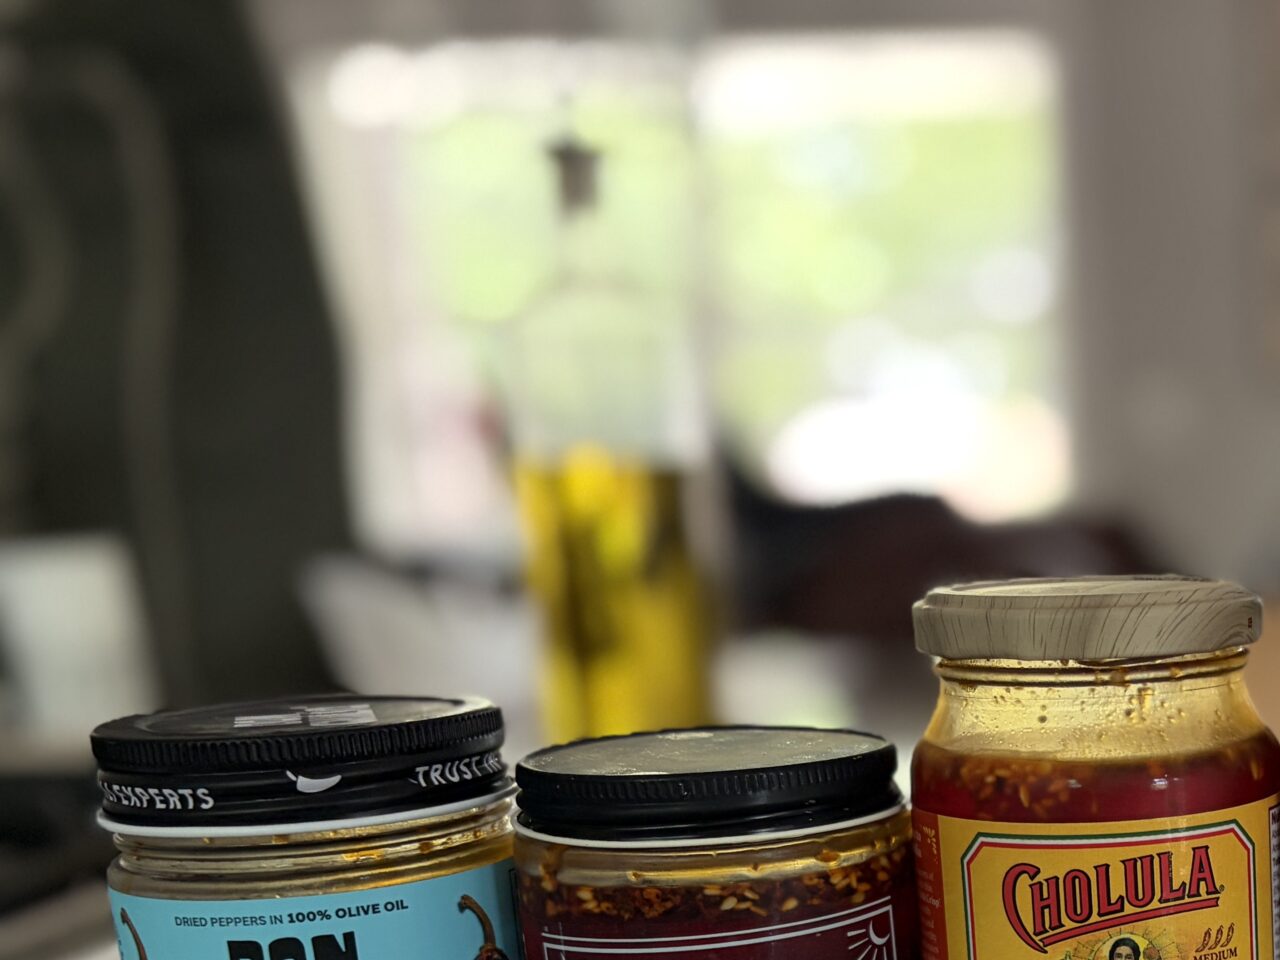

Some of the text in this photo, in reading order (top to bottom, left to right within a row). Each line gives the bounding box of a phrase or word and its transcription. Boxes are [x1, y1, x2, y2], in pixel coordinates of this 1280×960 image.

[415, 756, 481, 787] TRUST
[112, 784, 214, 809] EXPERTS
[174, 899, 409, 927] DRIED PEPPERS IN 100% OLIVE OIL
[1002, 845, 1220, 954] CHOLULA
